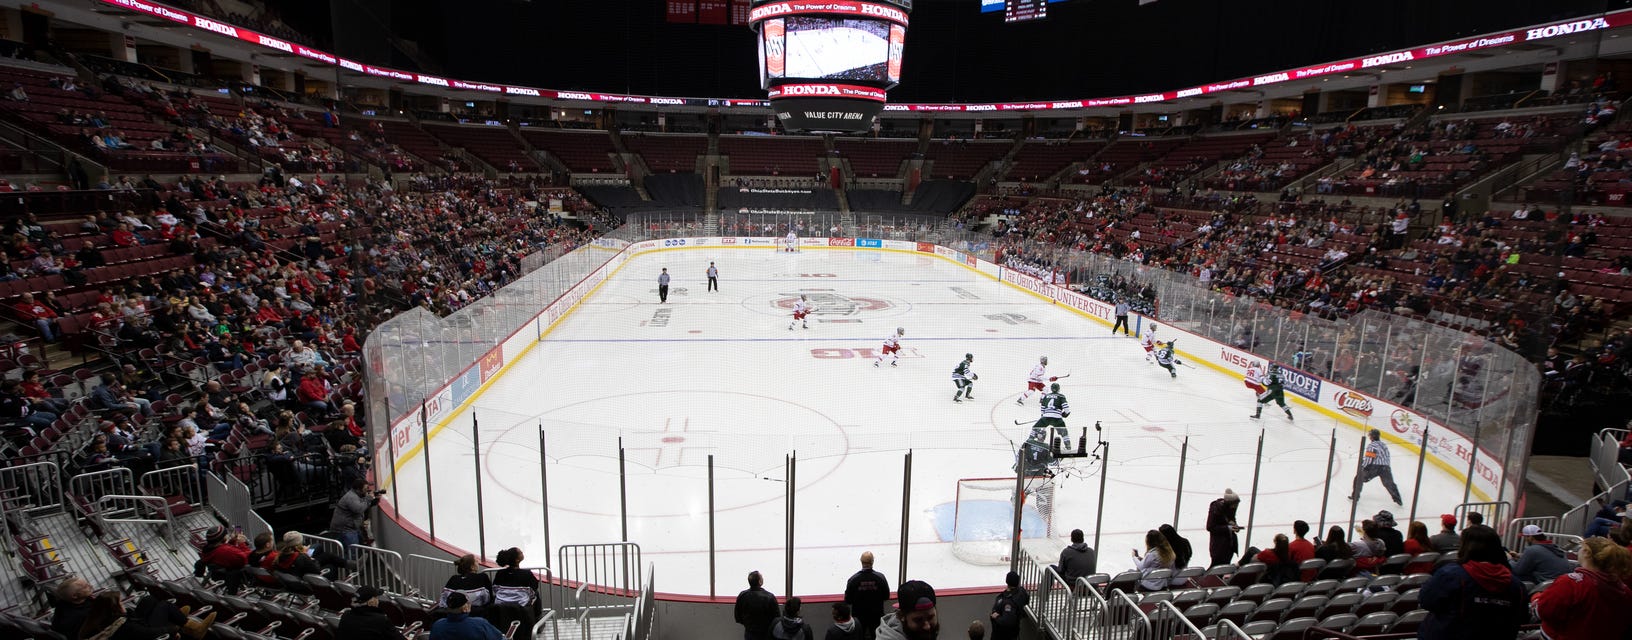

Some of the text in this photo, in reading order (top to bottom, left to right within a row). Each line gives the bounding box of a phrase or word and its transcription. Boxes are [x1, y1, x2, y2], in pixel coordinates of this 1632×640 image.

[130, 0, 153, 12] Power
[752, 4, 792, 19] HONDA
[861, 4, 904, 22] HONDA
[195, 17, 238, 37] HONDA
[1526, 18, 1609, 40] HONDA
[258, 36, 293, 52] HONDA
[1426, 35, 1514, 55] The Power of Dreams
[340, 59, 364, 72] HONDA
[1362, 51, 1414, 68] HONDA
[1307, 68, 1324, 76] Power
[418, 75, 449, 86] HONDA
[1253, 73, 1289, 86] HONDA
[506, 87, 540, 96] HONDA
[558, 91, 592, 100] HONDA
[784, 86, 841, 95] HONDA
[1176, 88, 1203, 98] HONDA
[1134, 94, 1164, 104] HONDA
[830, 238, 853, 246] Coca-Cola
[1004, 269, 1016, 284] THE
[1017, 274, 1033, 290] OHIO
[1034, 278, 1055, 299] STATE
[1056, 287, 1111, 320] UNIVERSITY
[1282, 368, 1319, 392] RUOFF
[1048, 399, 1054, 409] 4
